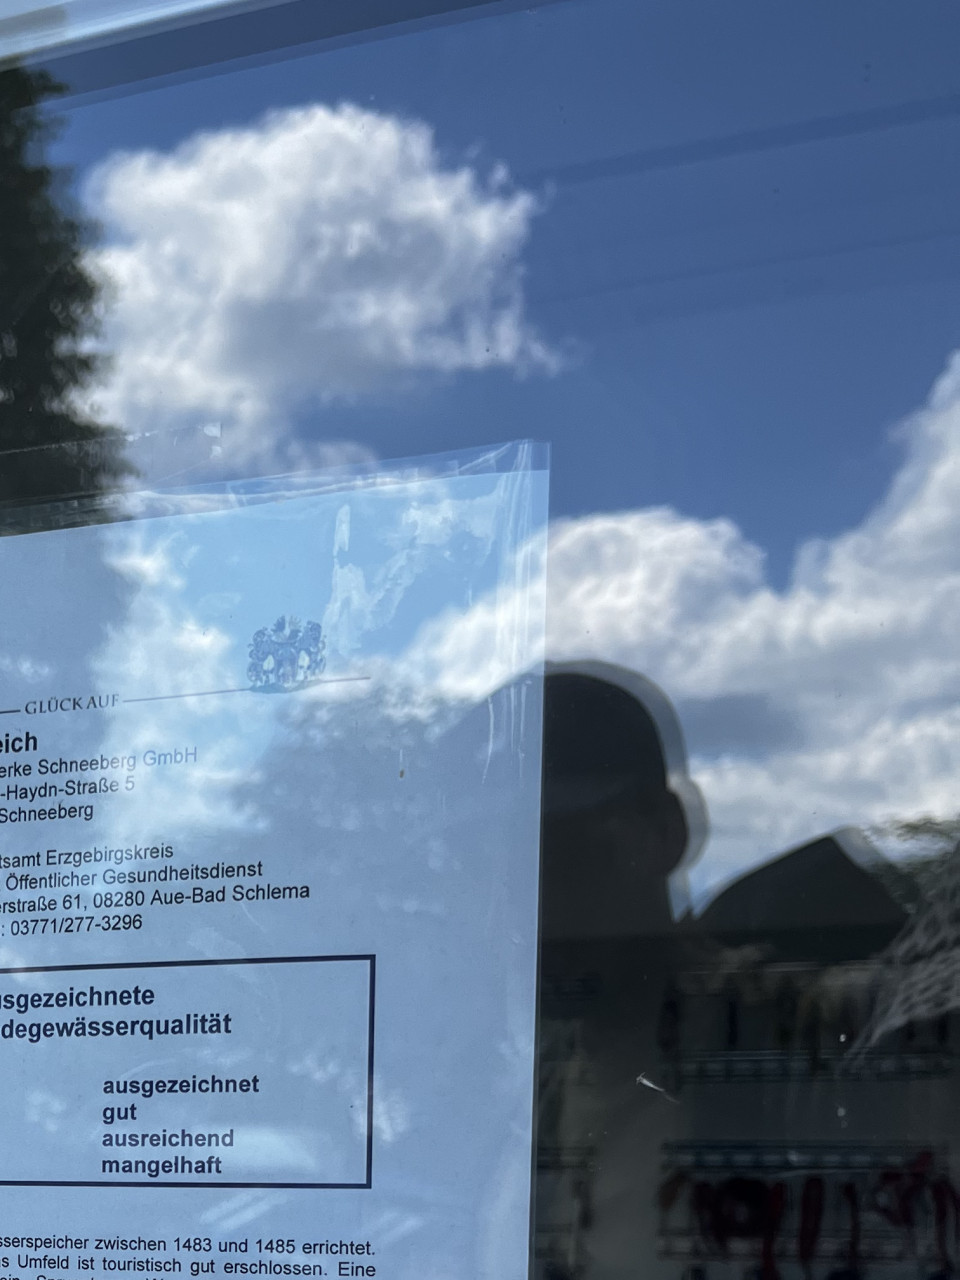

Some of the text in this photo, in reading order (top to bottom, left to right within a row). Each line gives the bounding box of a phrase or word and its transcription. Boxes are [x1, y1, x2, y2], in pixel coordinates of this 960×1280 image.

[24, 692, 120, 716] GLÜCK AUF
[37, 753, 136, 775] Schneeberg
[142, 746, 197, 766] GmbH
[123, 774, 135, 792] 5
[46, 842, 173, 868] Erzgebirgskreis
[5, 870, 97, 891] Öffentlicher
[102, 861, 262, 884] Gesundheitsdienst
[62, 893, 87, 911] 61,
[93, 890, 145, 908] 08280
[150, 885, 225, 905] Aue-Bad
[232, 883, 310, 901] Schlema
[10, 913, 142, 936] 03771/277-3296
[103, 1074, 259, 1098] ausgezeichnet
[102, 1103, 137, 1124] gut
[102, 1128, 234, 1147] ausreichend
[101, 1155, 222, 1178] mangelhaft
[94, 1235, 166, 1251] zwischen
[173, 1237, 212, 1252] 1483
[218, 1238, 248, 1253] und
[255, 1238, 296, 1254] 1485
[301, 1239, 371, 1255] errichtet.
